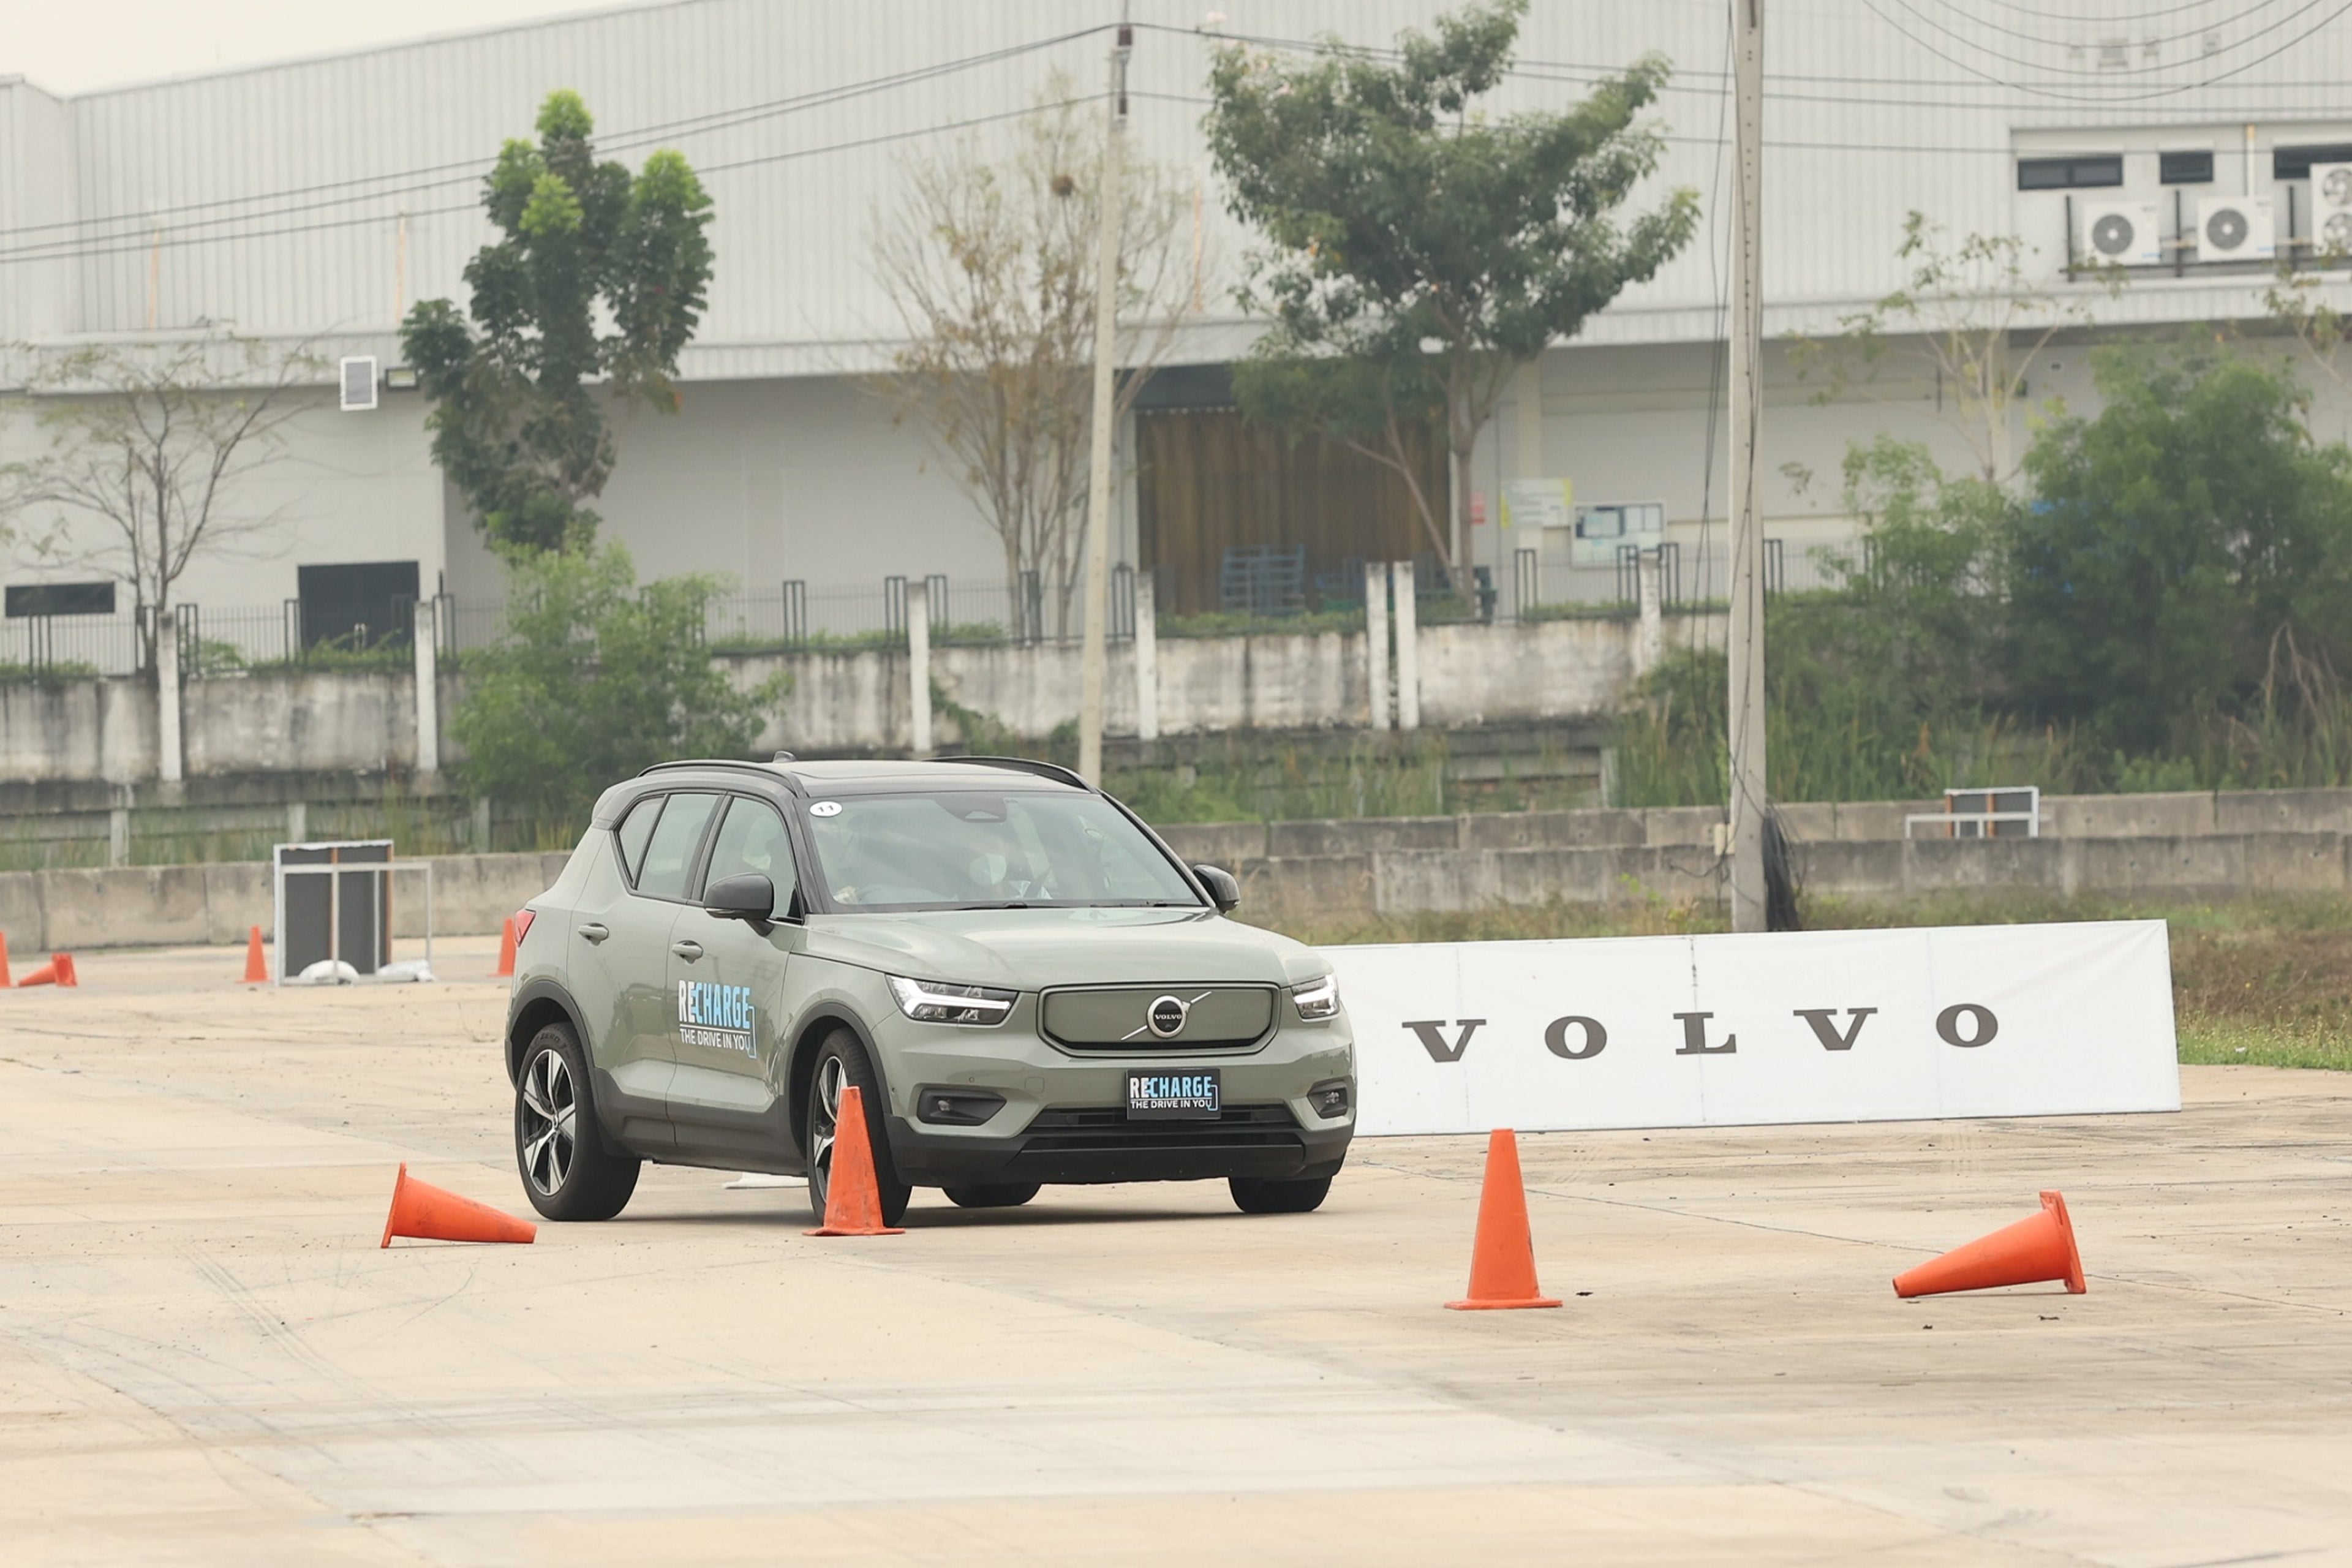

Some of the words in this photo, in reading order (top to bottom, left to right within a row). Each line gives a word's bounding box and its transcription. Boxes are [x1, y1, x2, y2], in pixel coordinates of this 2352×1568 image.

[679, 979, 750, 1029] RECHARGE
[679, 1028, 696, 1045] THE
[697, 1030, 722, 1048] DRIVE
[723, 1033, 733, 1049] IN
[733, 1034, 751, 1050] YOU
[1402, 1003, 1998, 1062] VOLVO
[1129, 1076, 1213, 1098] RECHARGE
[1131, 1101, 1149, 1109] THE
[1150, 1100, 1178, 1109] DRIVE
[1192, 1099, 1212, 1109] YOU
